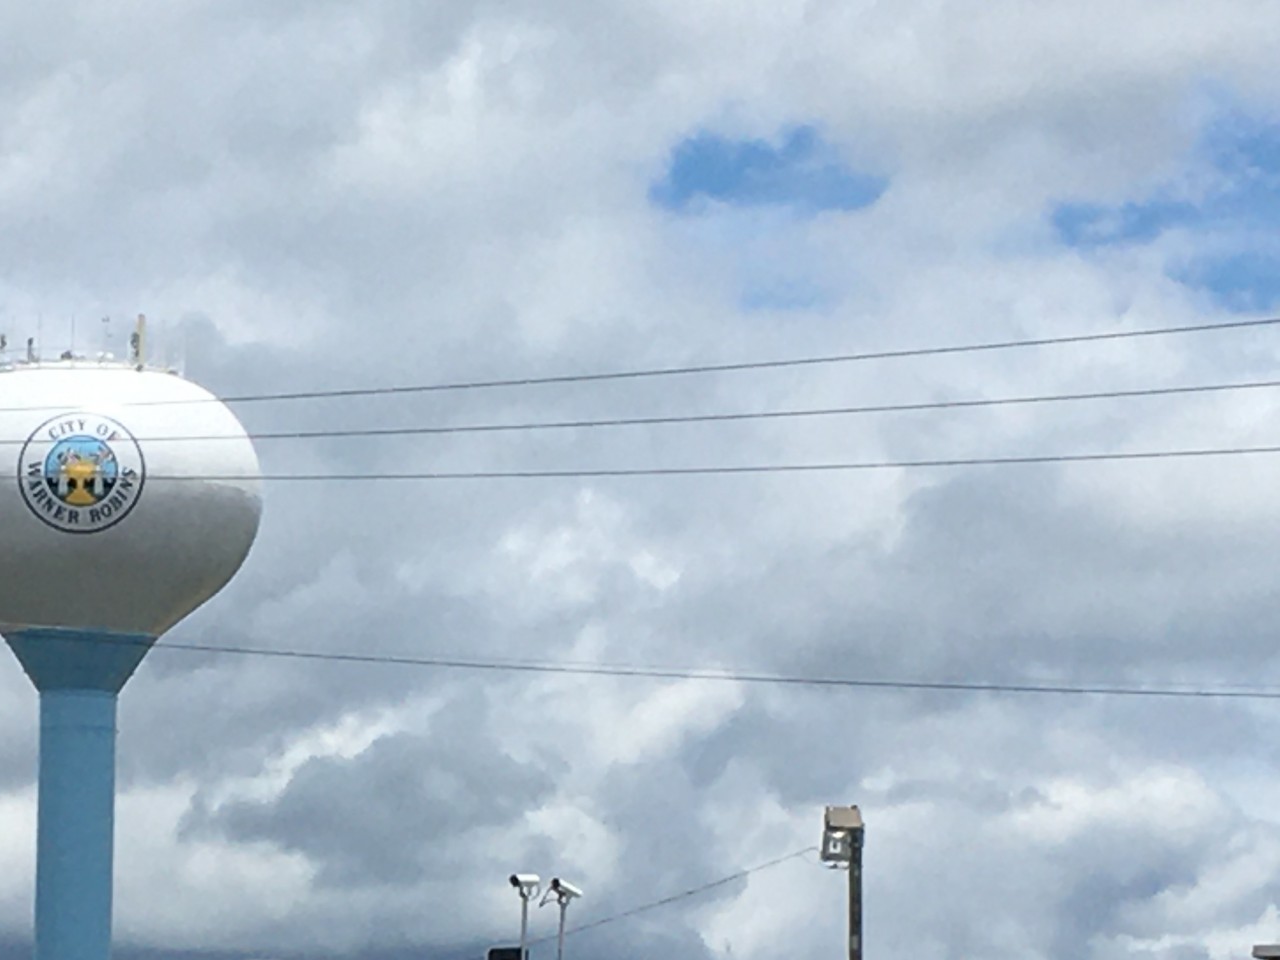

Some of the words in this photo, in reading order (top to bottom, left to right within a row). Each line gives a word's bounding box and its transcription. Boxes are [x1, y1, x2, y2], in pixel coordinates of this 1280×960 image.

[48, 419, 86, 441] CITY
[96, 423, 122, 441] OF
[28, 461, 80, 524] WARNER
[89, 467, 138, 524] ROBINS
